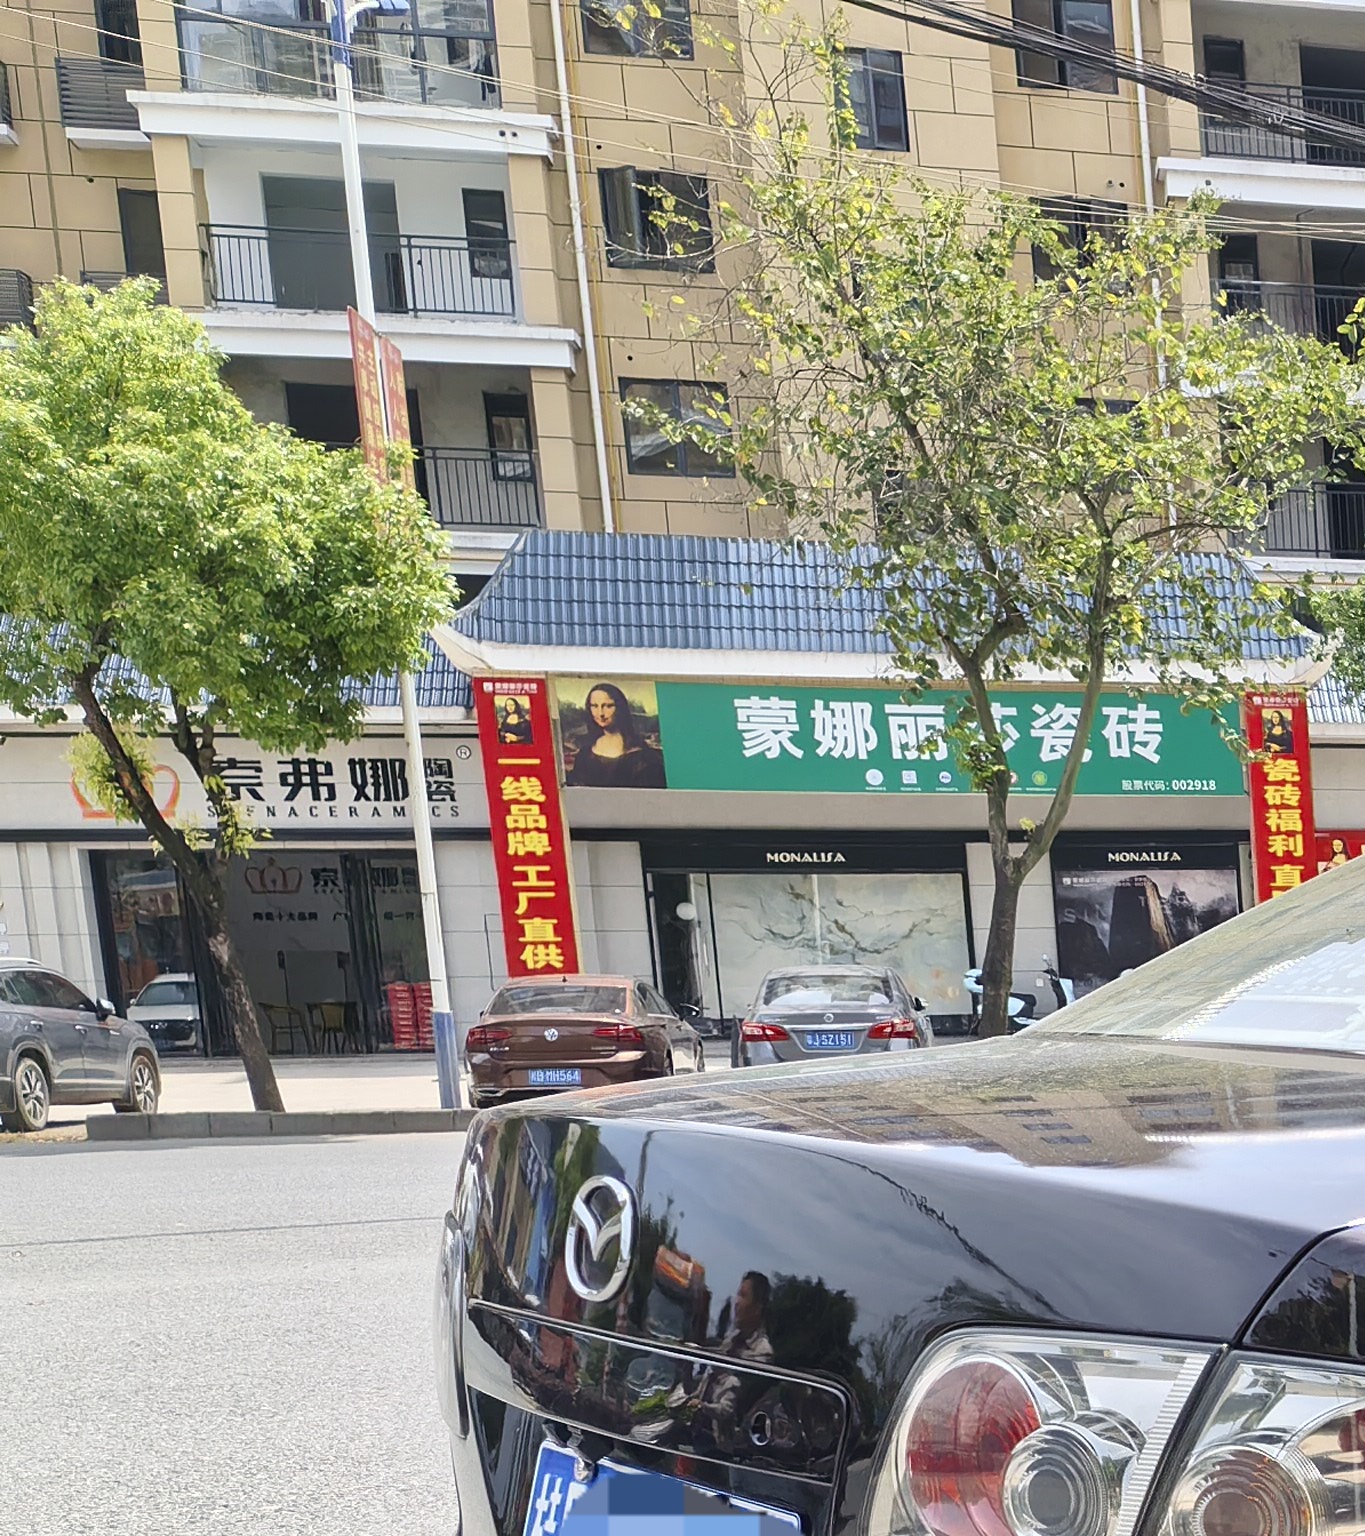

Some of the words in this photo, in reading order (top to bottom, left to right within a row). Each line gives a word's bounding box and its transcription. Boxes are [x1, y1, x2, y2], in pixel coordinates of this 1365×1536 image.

[1263, 758, 1304, 898] 瓷砖福利直
[766, 852, 846, 862] MONALISA
[1108, 852, 1182, 862] MONALISA
